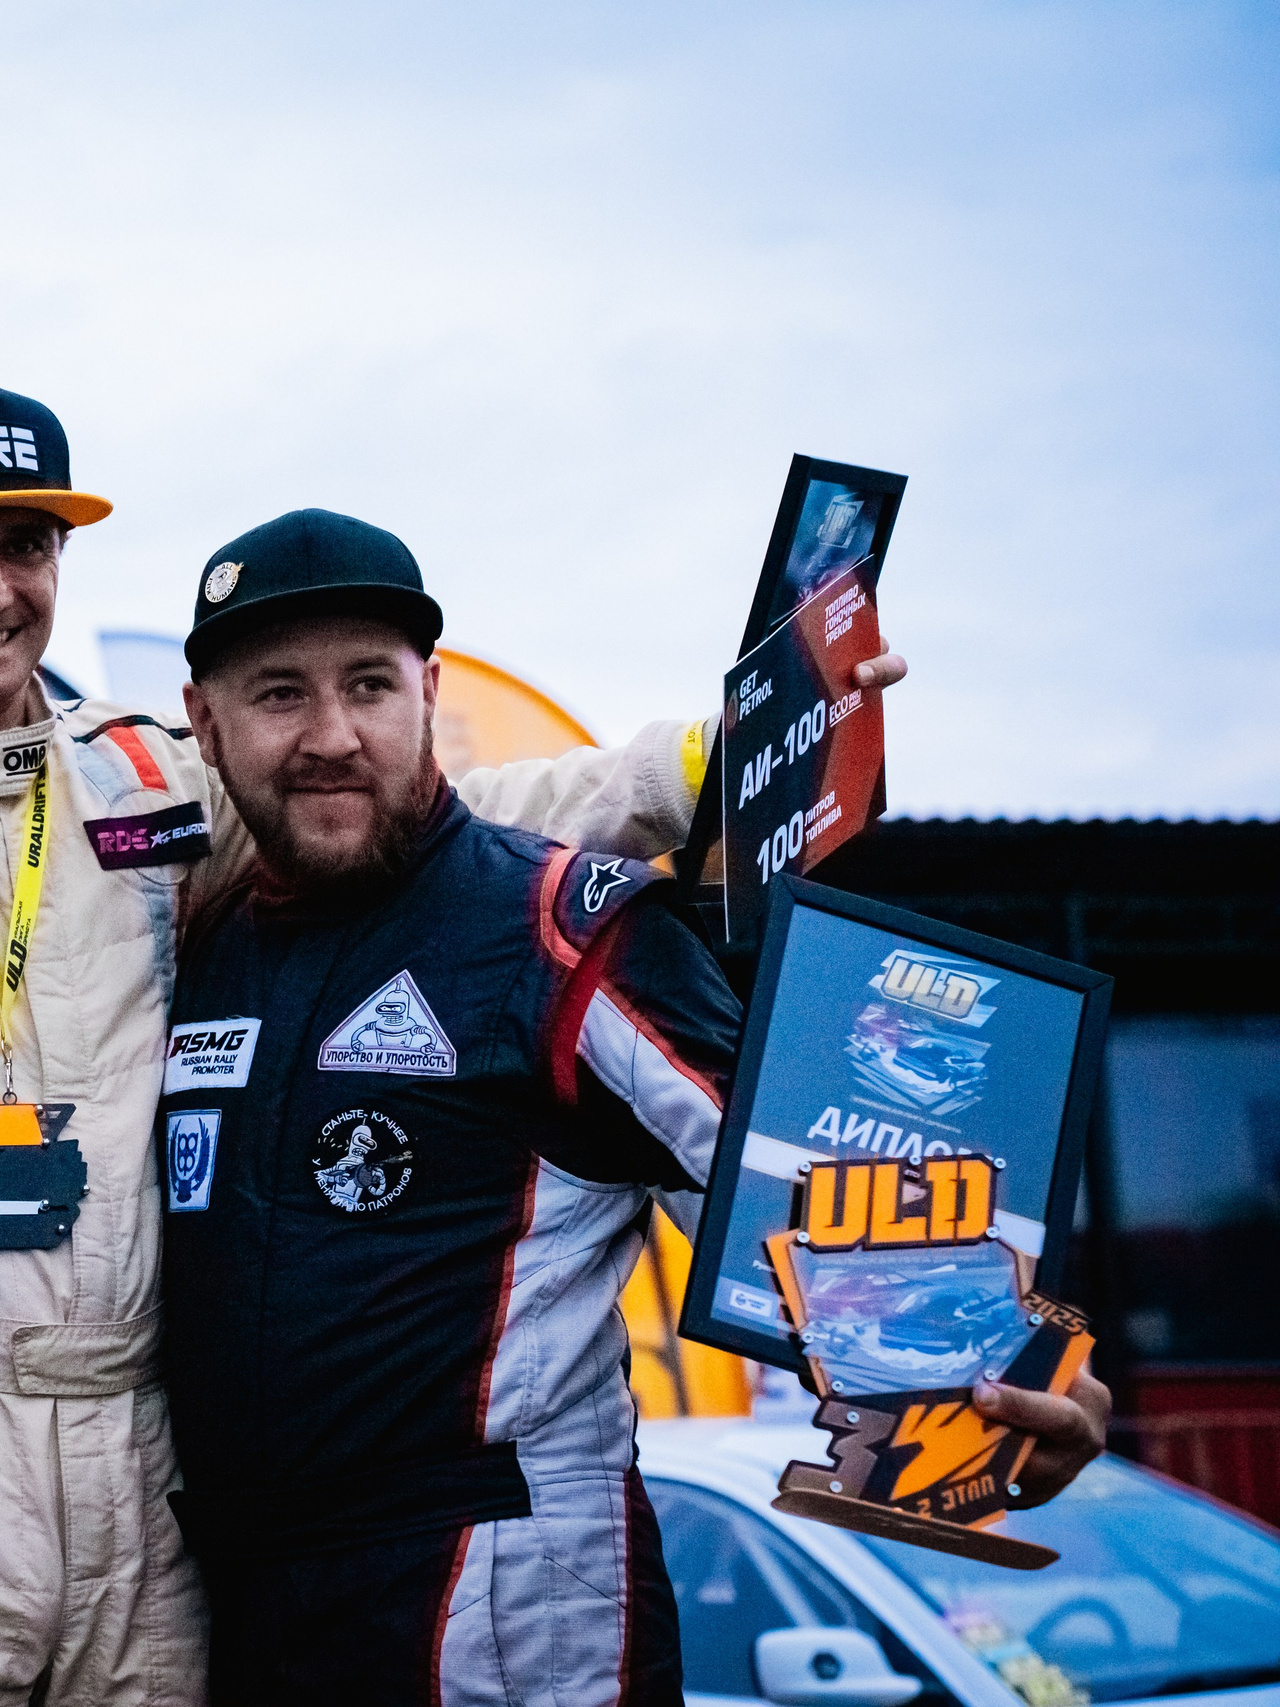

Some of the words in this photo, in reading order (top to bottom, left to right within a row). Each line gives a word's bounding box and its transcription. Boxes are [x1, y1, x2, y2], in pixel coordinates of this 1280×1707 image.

[825, 584, 859, 620] ТОПЛИВО
[825, 593, 866, 634] ГОНОЧНЫХ
[825, 616, 852, 647] ТРЕКОВ
[739, 670, 759, 699] GET
[739, 679, 773, 720] PETROL
[3, 745, 46, 772] OMP
[738, 699, 826, 810] АИ-100
[829, 694, 848, 725] ECO
[805, 790, 835, 827] ЛИТРОВ
[806, 805, 842, 844] ТОПЛИВА
[756, 810, 804, 885] 100
[6, 938, 28, 992] ULD
[881, 957, 982, 1017] ULD
[181, 1055, 213, 1066] RUSSIAN
[214, 1054, 238, 1064] RALLY
[191, 1065, 235, 1075] PROMOTER
[325, 1049, 373, 1064] УПОРСТВО
[375, 1051, 382, 1064] И
[385, 1053, 448, 1069] УПОРОТОСТЬ
[371, 1110, 409, 1144] КУЧНЕЕ
[807, 1106, 972, 1158] ДИПЛО
[368, 1167, 412, 1211] ПАТРОНОВ
[808, 1160, 992, 1247] ULD
